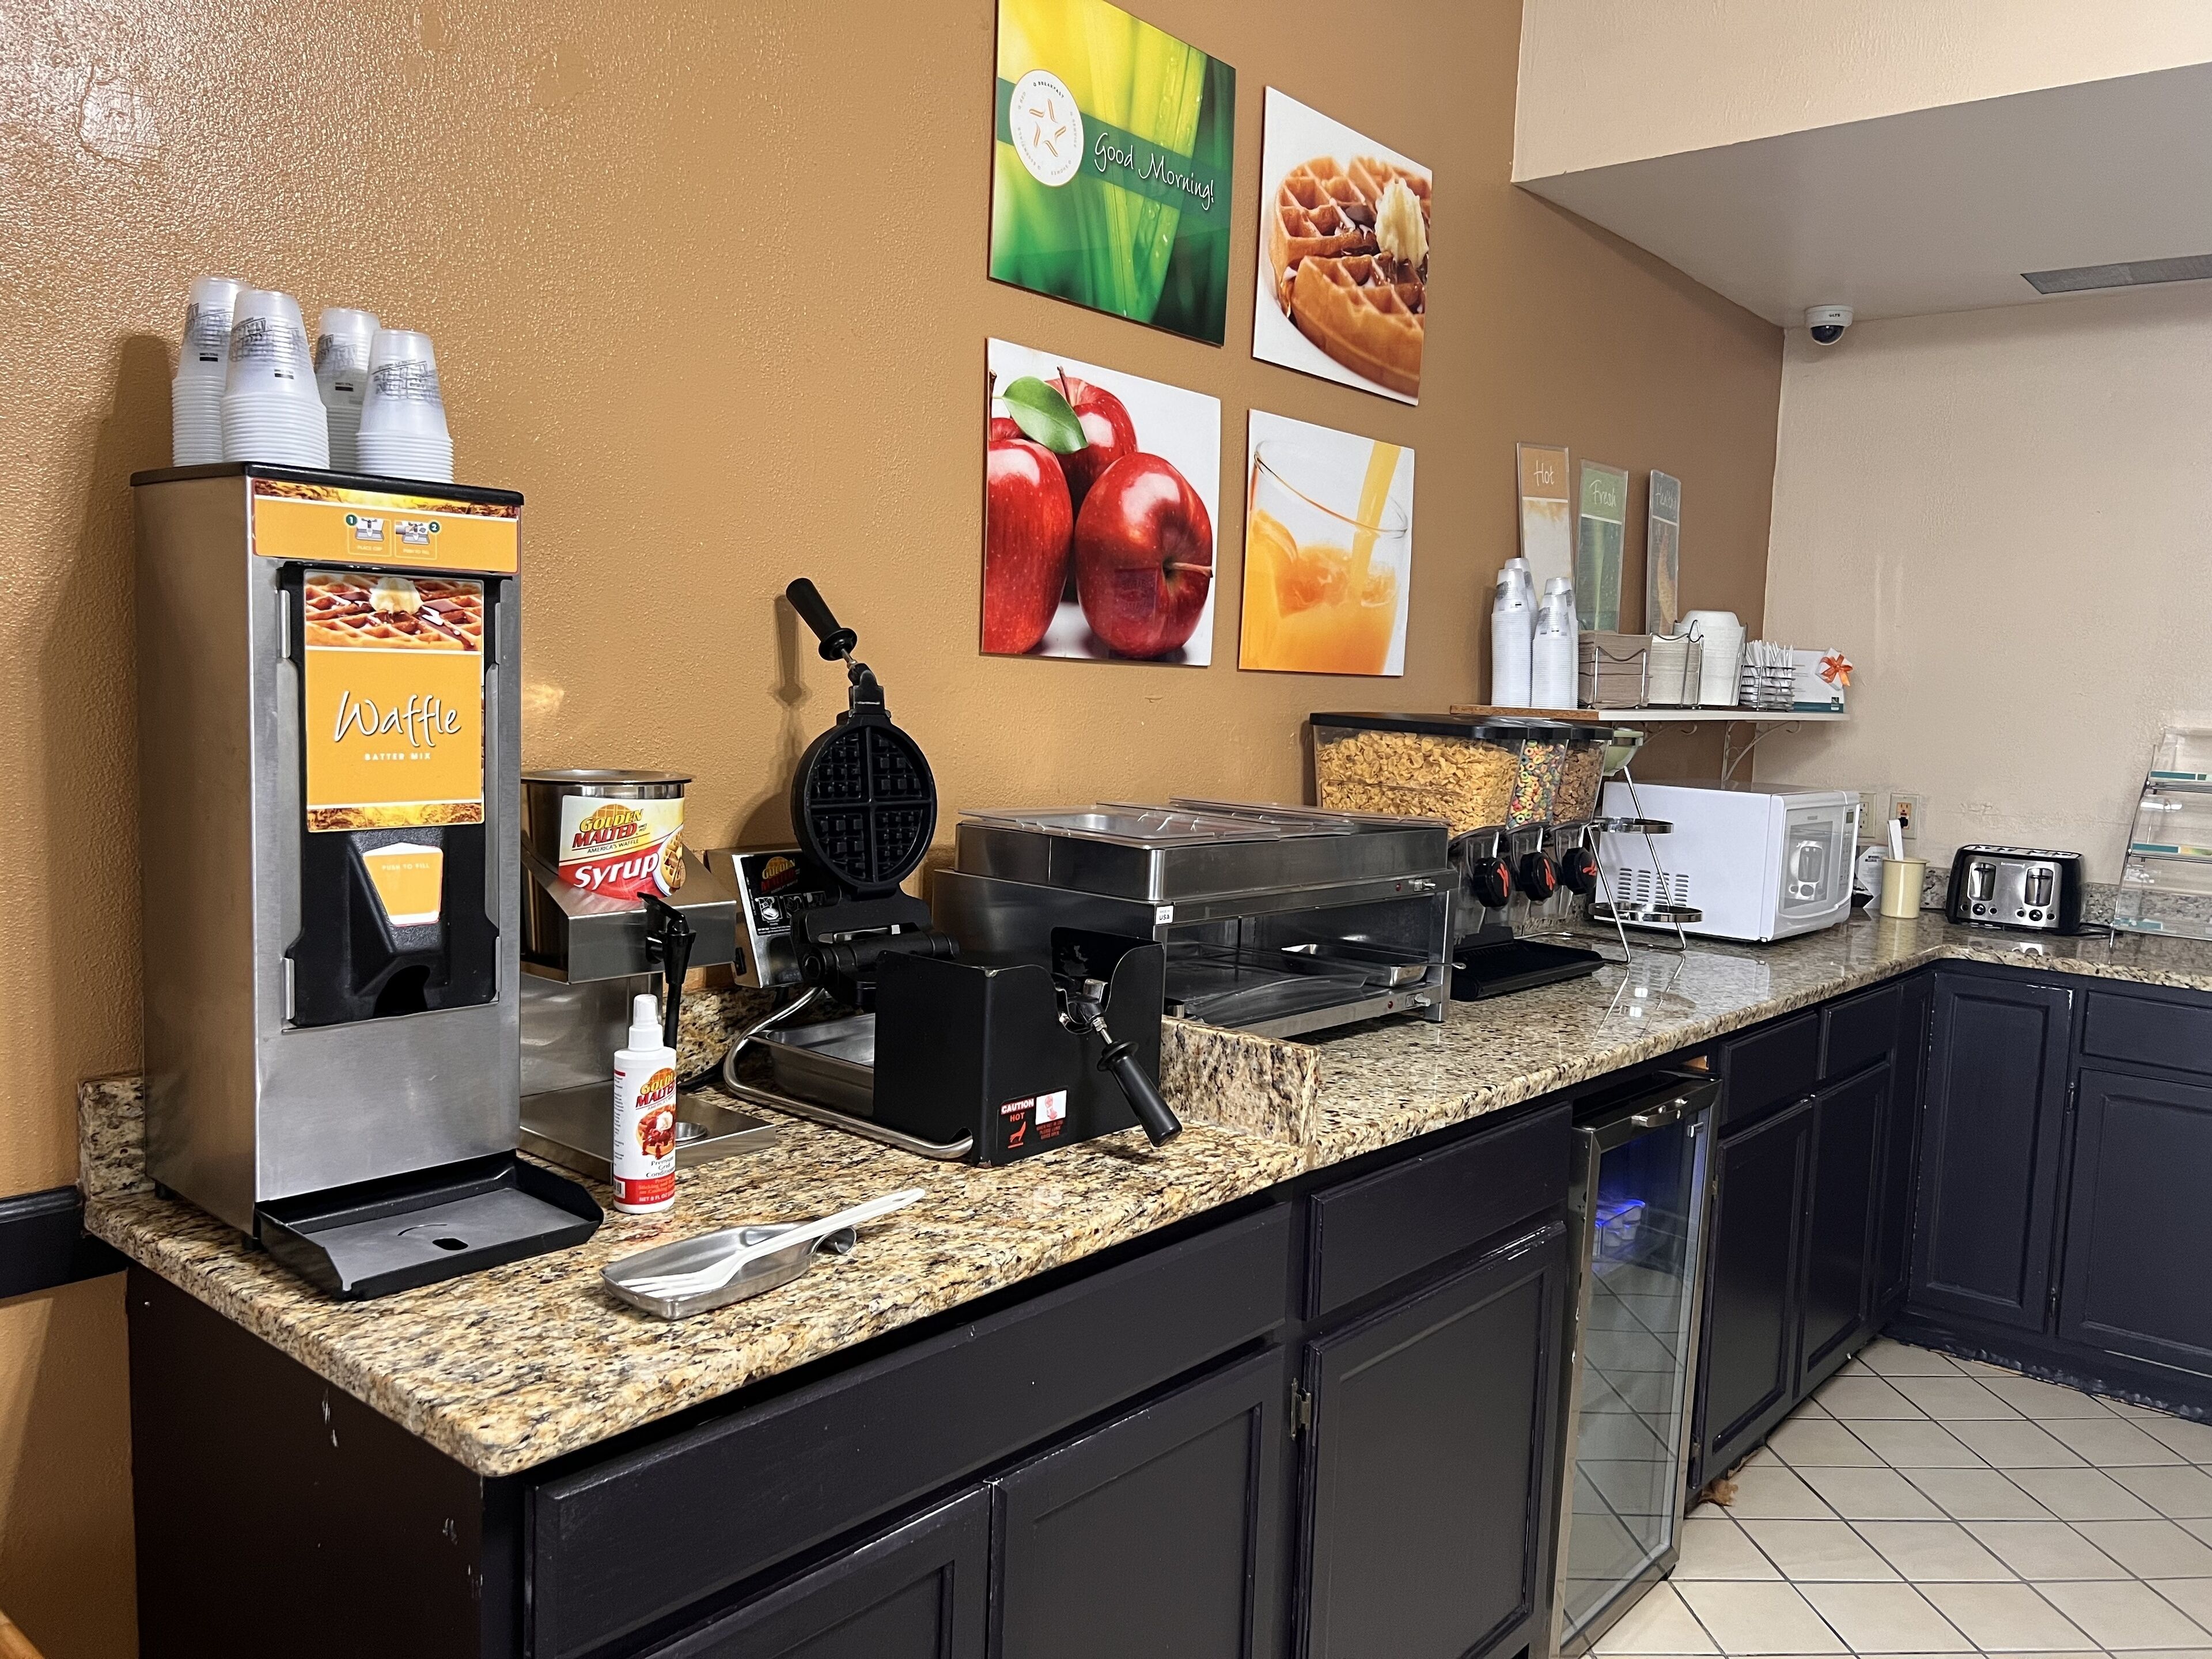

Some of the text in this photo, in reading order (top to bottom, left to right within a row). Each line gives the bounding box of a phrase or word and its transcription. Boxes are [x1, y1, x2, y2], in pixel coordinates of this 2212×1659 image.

[1037, 81, 1065, 99] BREAKFAST
[1094, 132, 1214, 211] Good Morning!
[1533, 460, 1554, 487] Hot
[1589, 479, 1617, 507] Fresh
[334, 690, 461, 748] Waffle
[364, 752, 431, 761] BATTER MIX
[579, 809, 644, 833] GOLDEN
[571, 823, 638, 849] MALTED
[587, 838, 640, 854] AMERICA'S WAFFLE
[573, 852, 660, 891] Syrup
[1001, 1098, 1035, 1115] CAUTION
[1010, 1112, 1025, 1123] HOT
[658, 1162, 671, 1171] Grid
